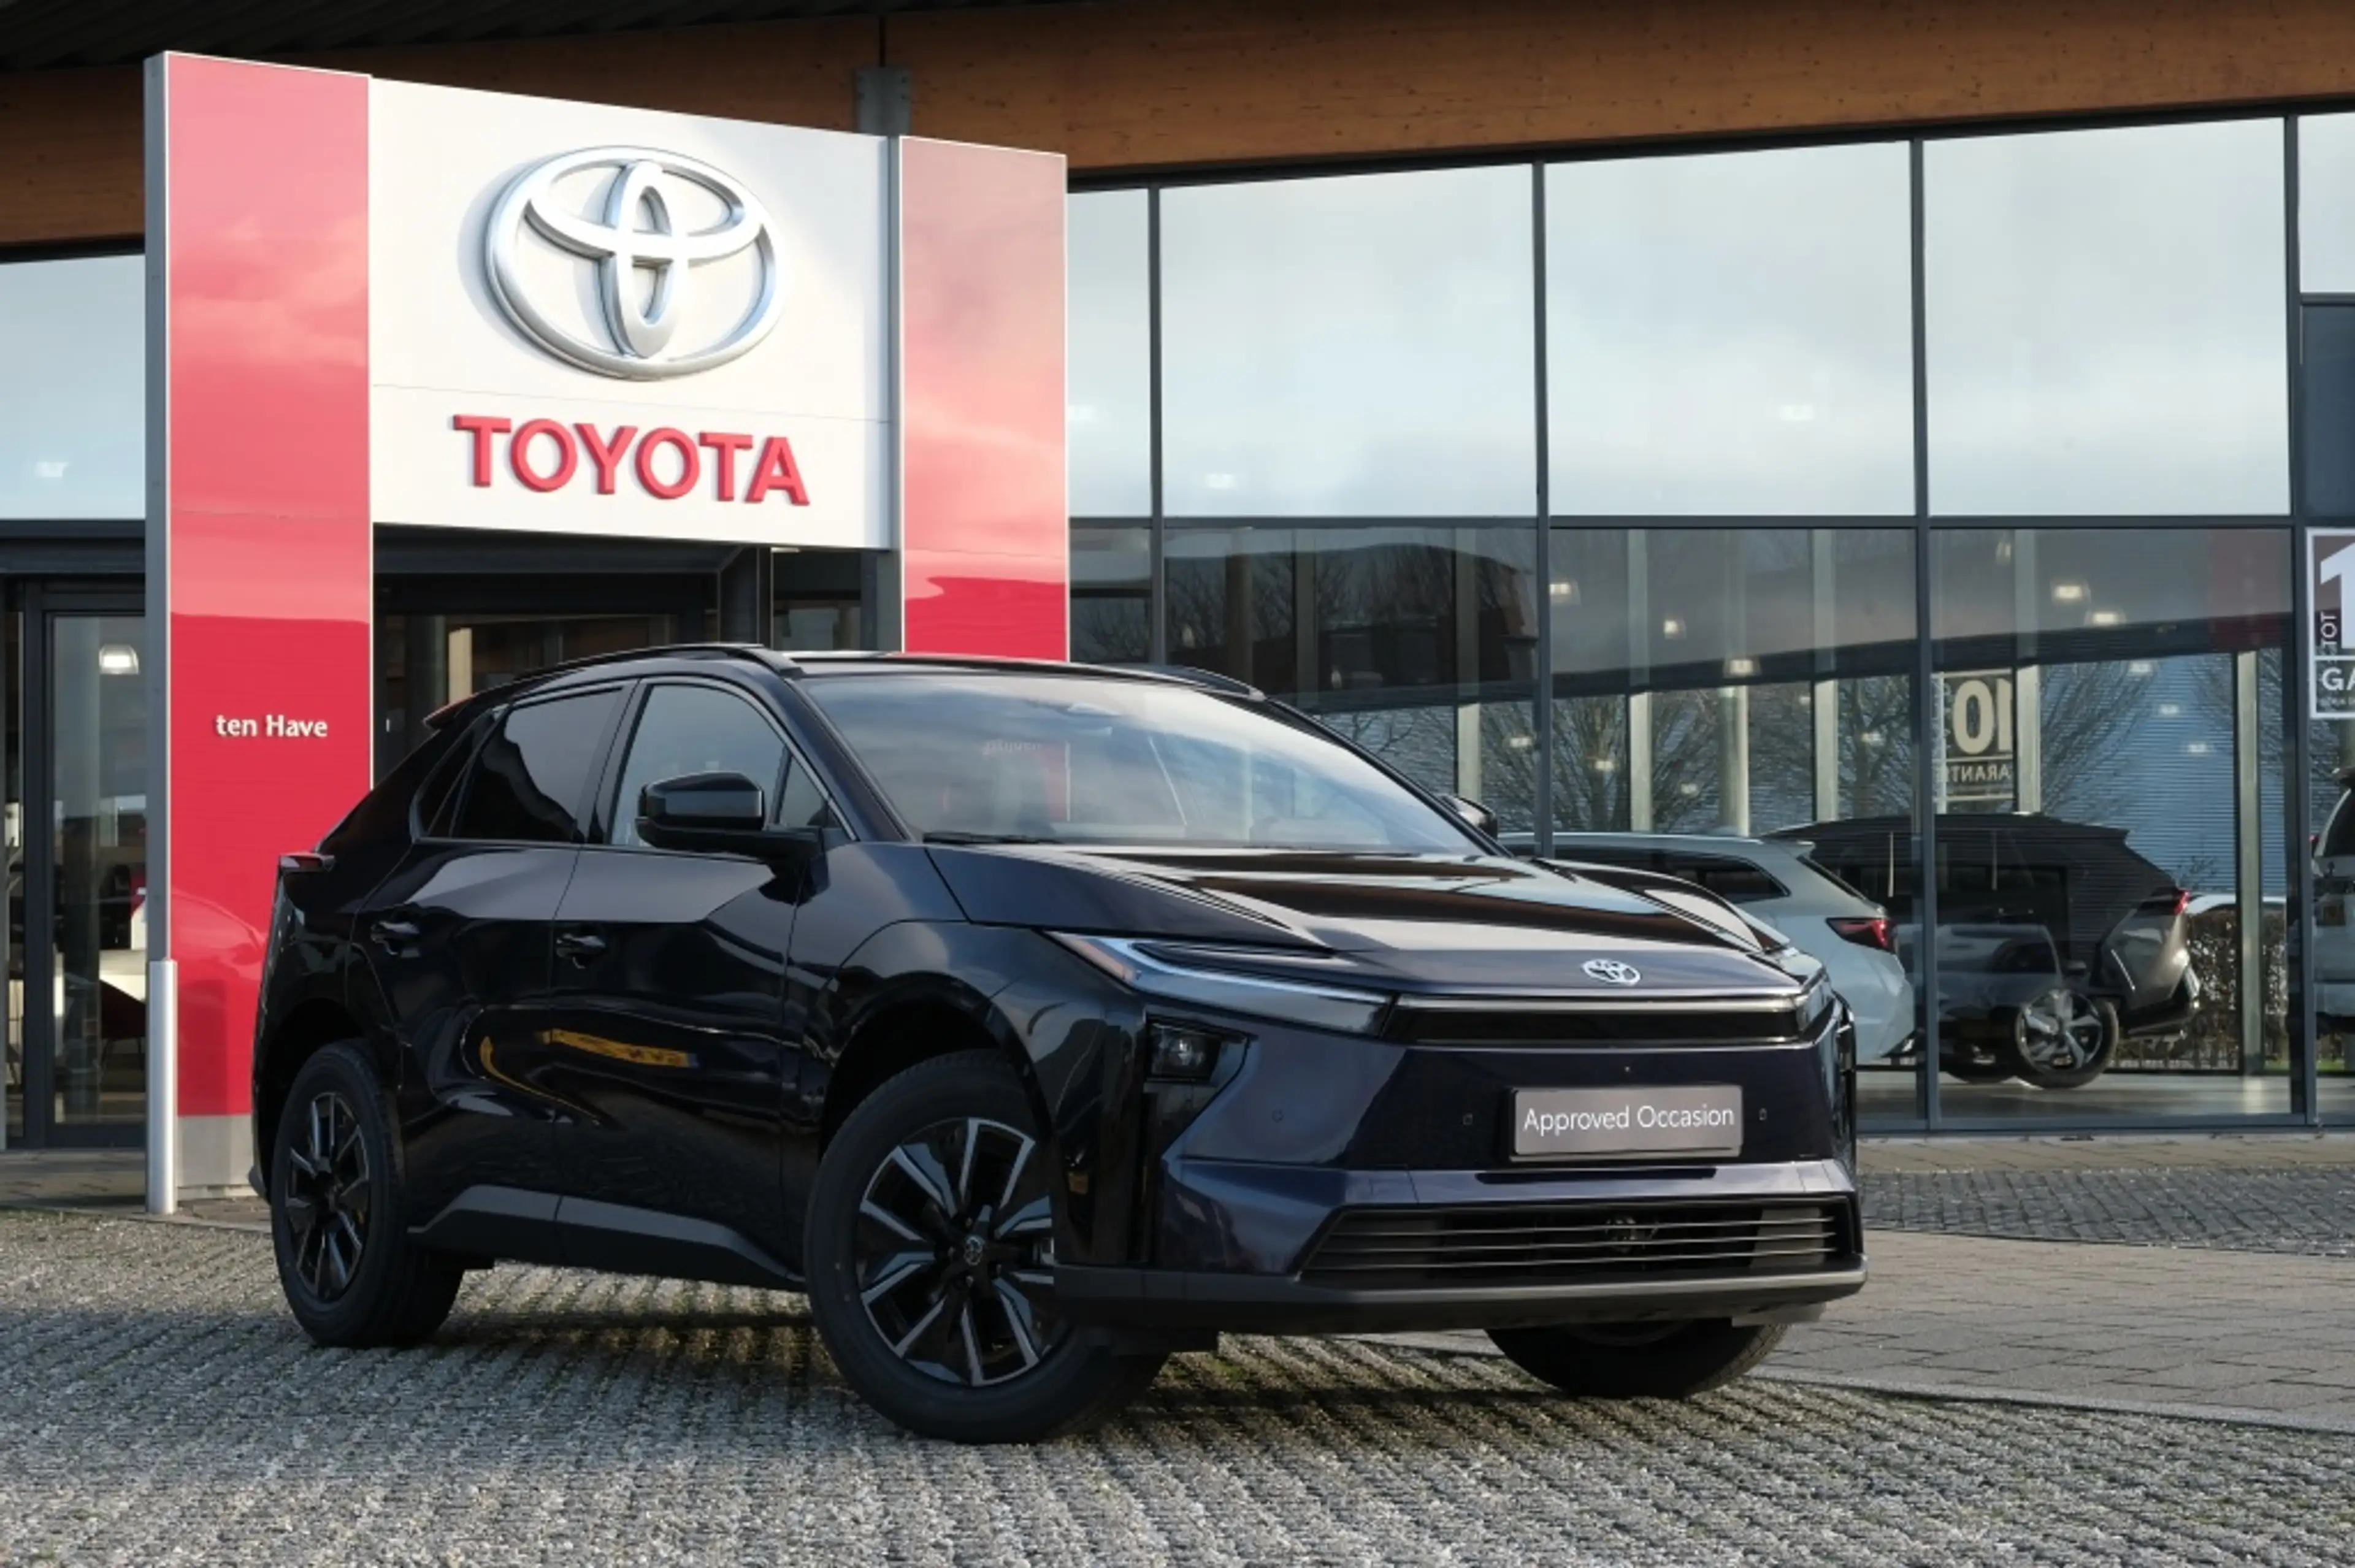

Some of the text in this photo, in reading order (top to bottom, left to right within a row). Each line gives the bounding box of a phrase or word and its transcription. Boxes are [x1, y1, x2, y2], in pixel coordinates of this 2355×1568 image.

[453, 414, 810, 507] TOYOTA
[2320, 611, 2337, 649] TOT
[216, 714, 327, 737] ten Have
[1523, 1104, 1735, 1136] Approved Occasion
